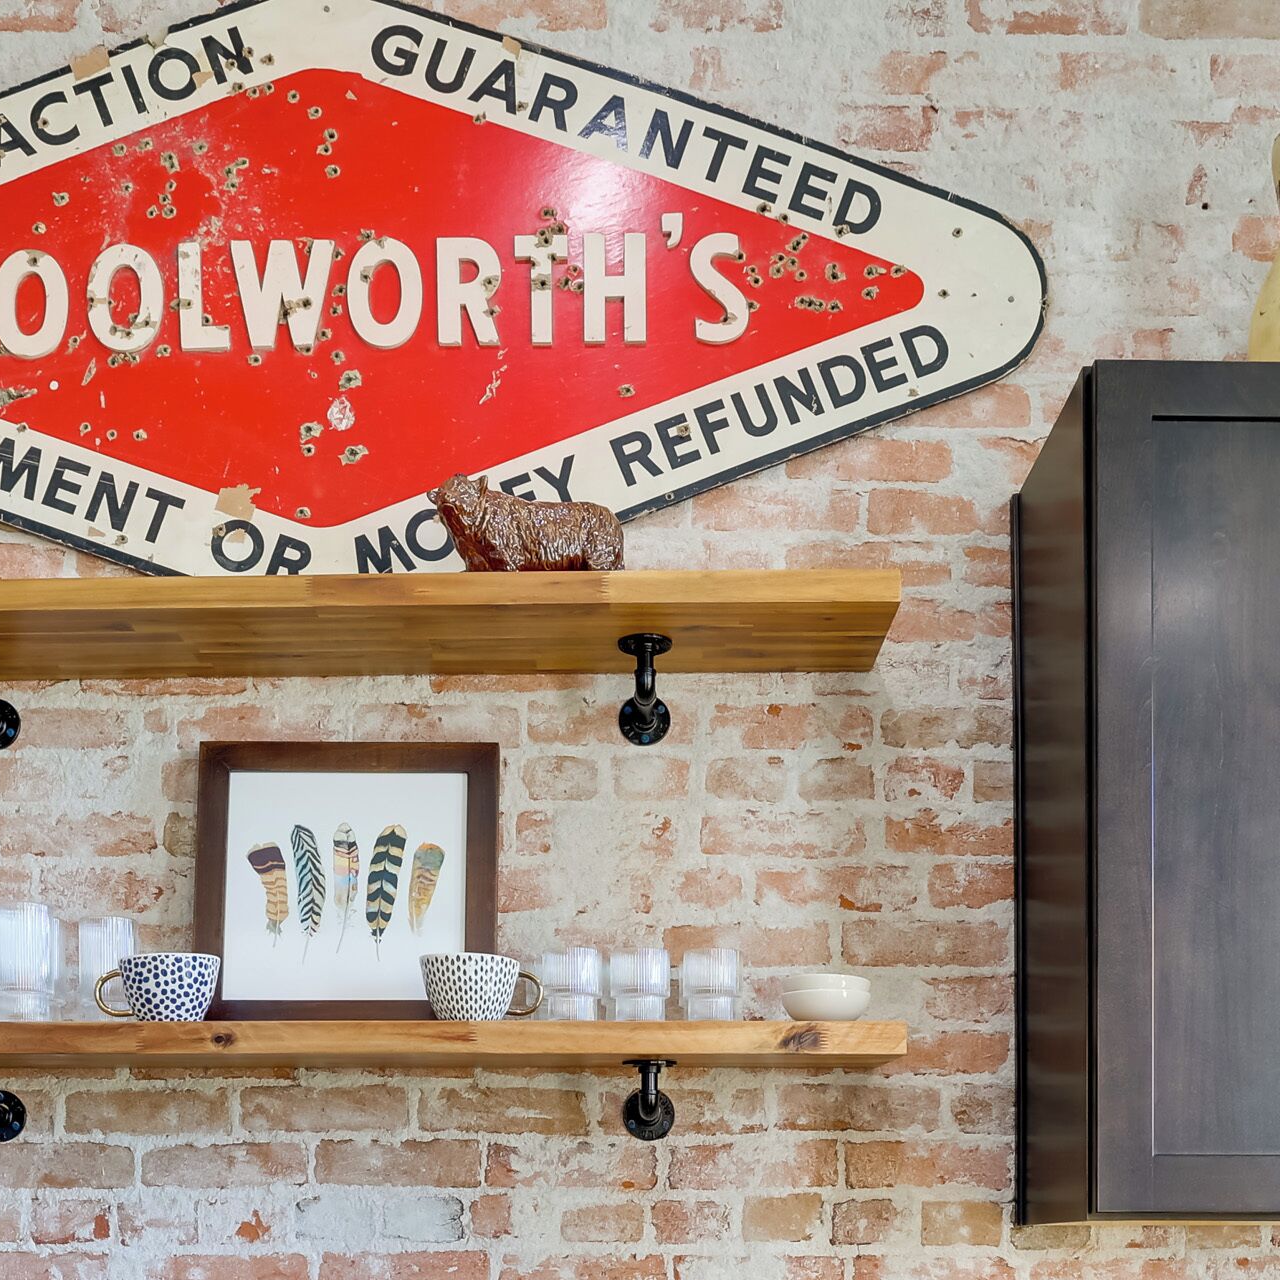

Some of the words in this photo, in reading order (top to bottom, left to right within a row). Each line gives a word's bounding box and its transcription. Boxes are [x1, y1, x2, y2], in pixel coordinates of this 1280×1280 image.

[370, 24, 883, 236] GUARANTEED
[211, 519, 312, 575] OR
[353, 453, 576, 574] MOEY
[608, 324, 950, 488] REFUNDED
